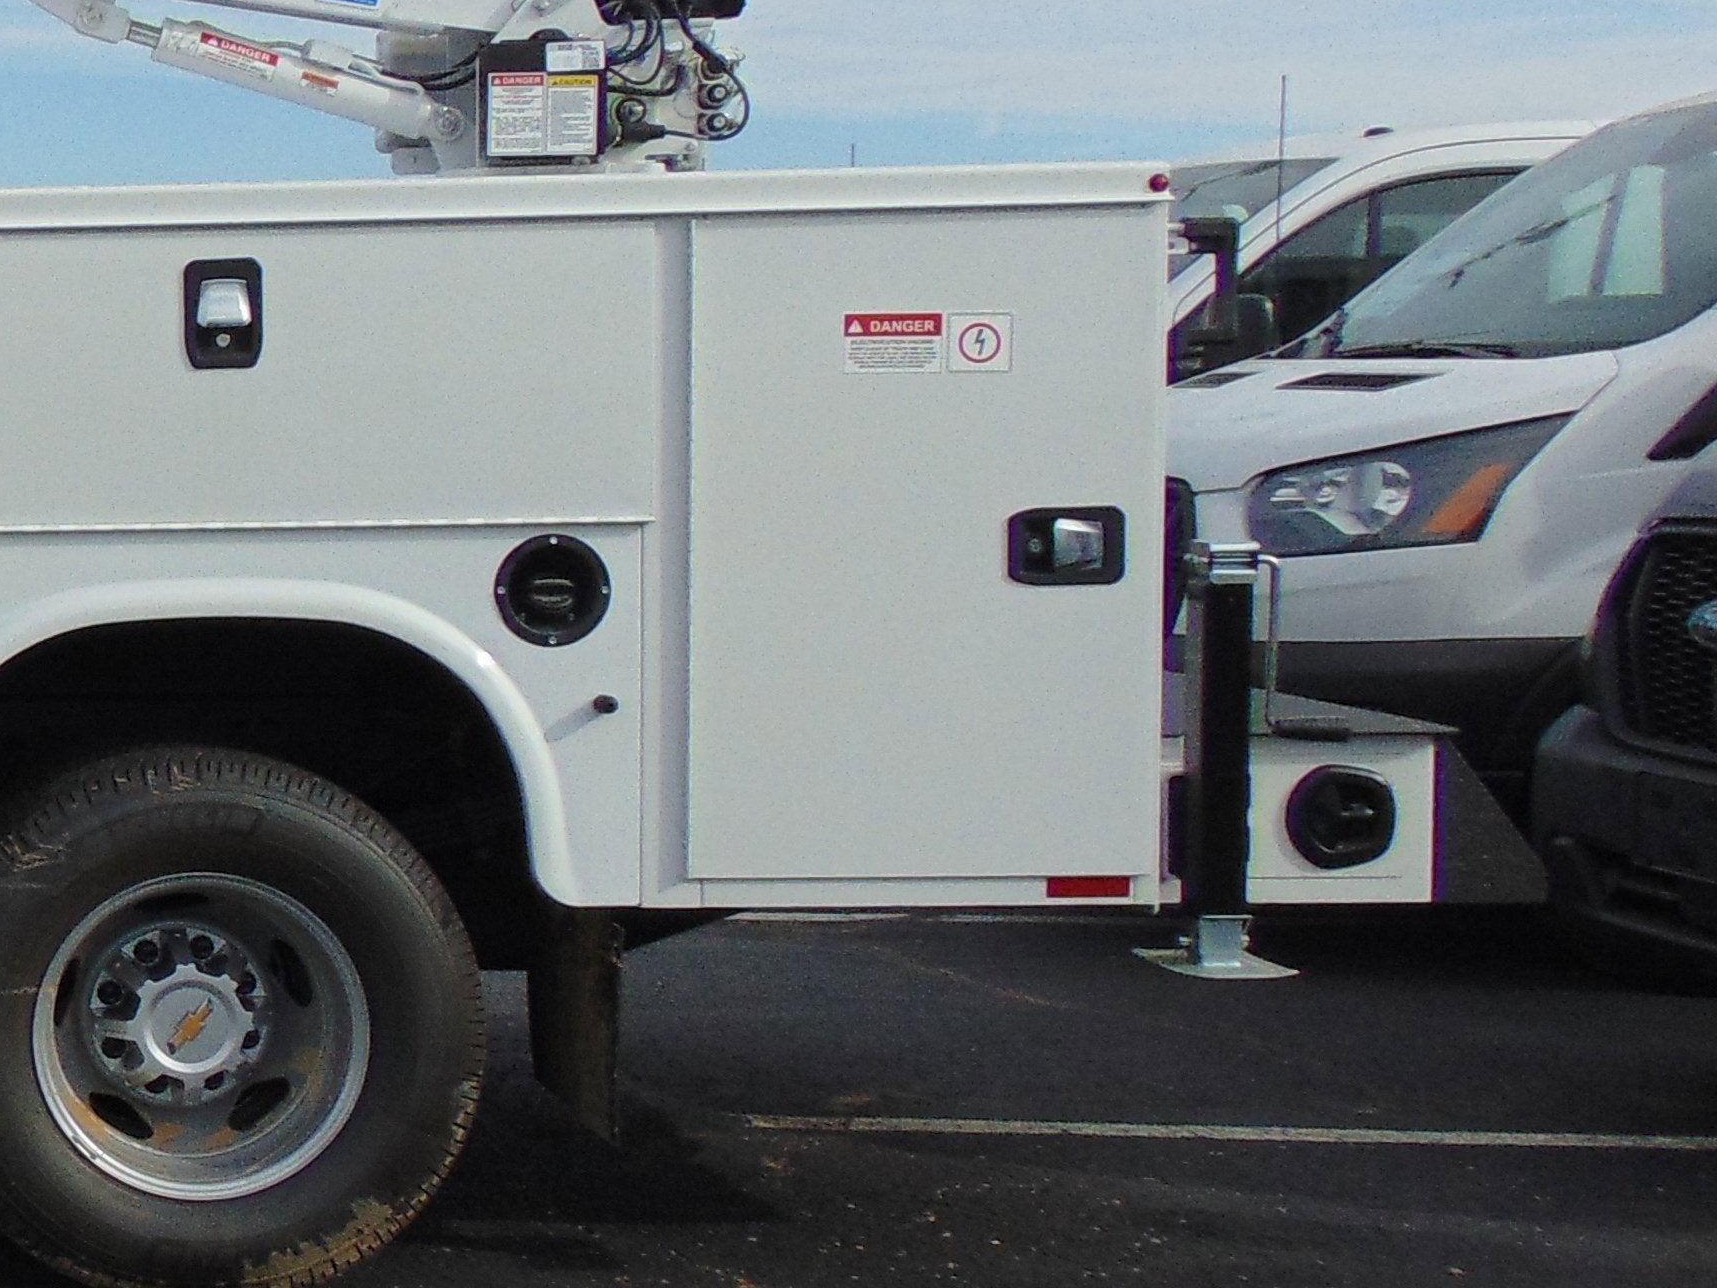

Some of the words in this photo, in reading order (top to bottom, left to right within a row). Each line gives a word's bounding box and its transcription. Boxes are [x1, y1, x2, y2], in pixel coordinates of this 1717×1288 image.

[221, 39, 271, 62] DANGER
[502, 76, 542, 85] DANGER
[869, 319, 936, 333] DANGER
